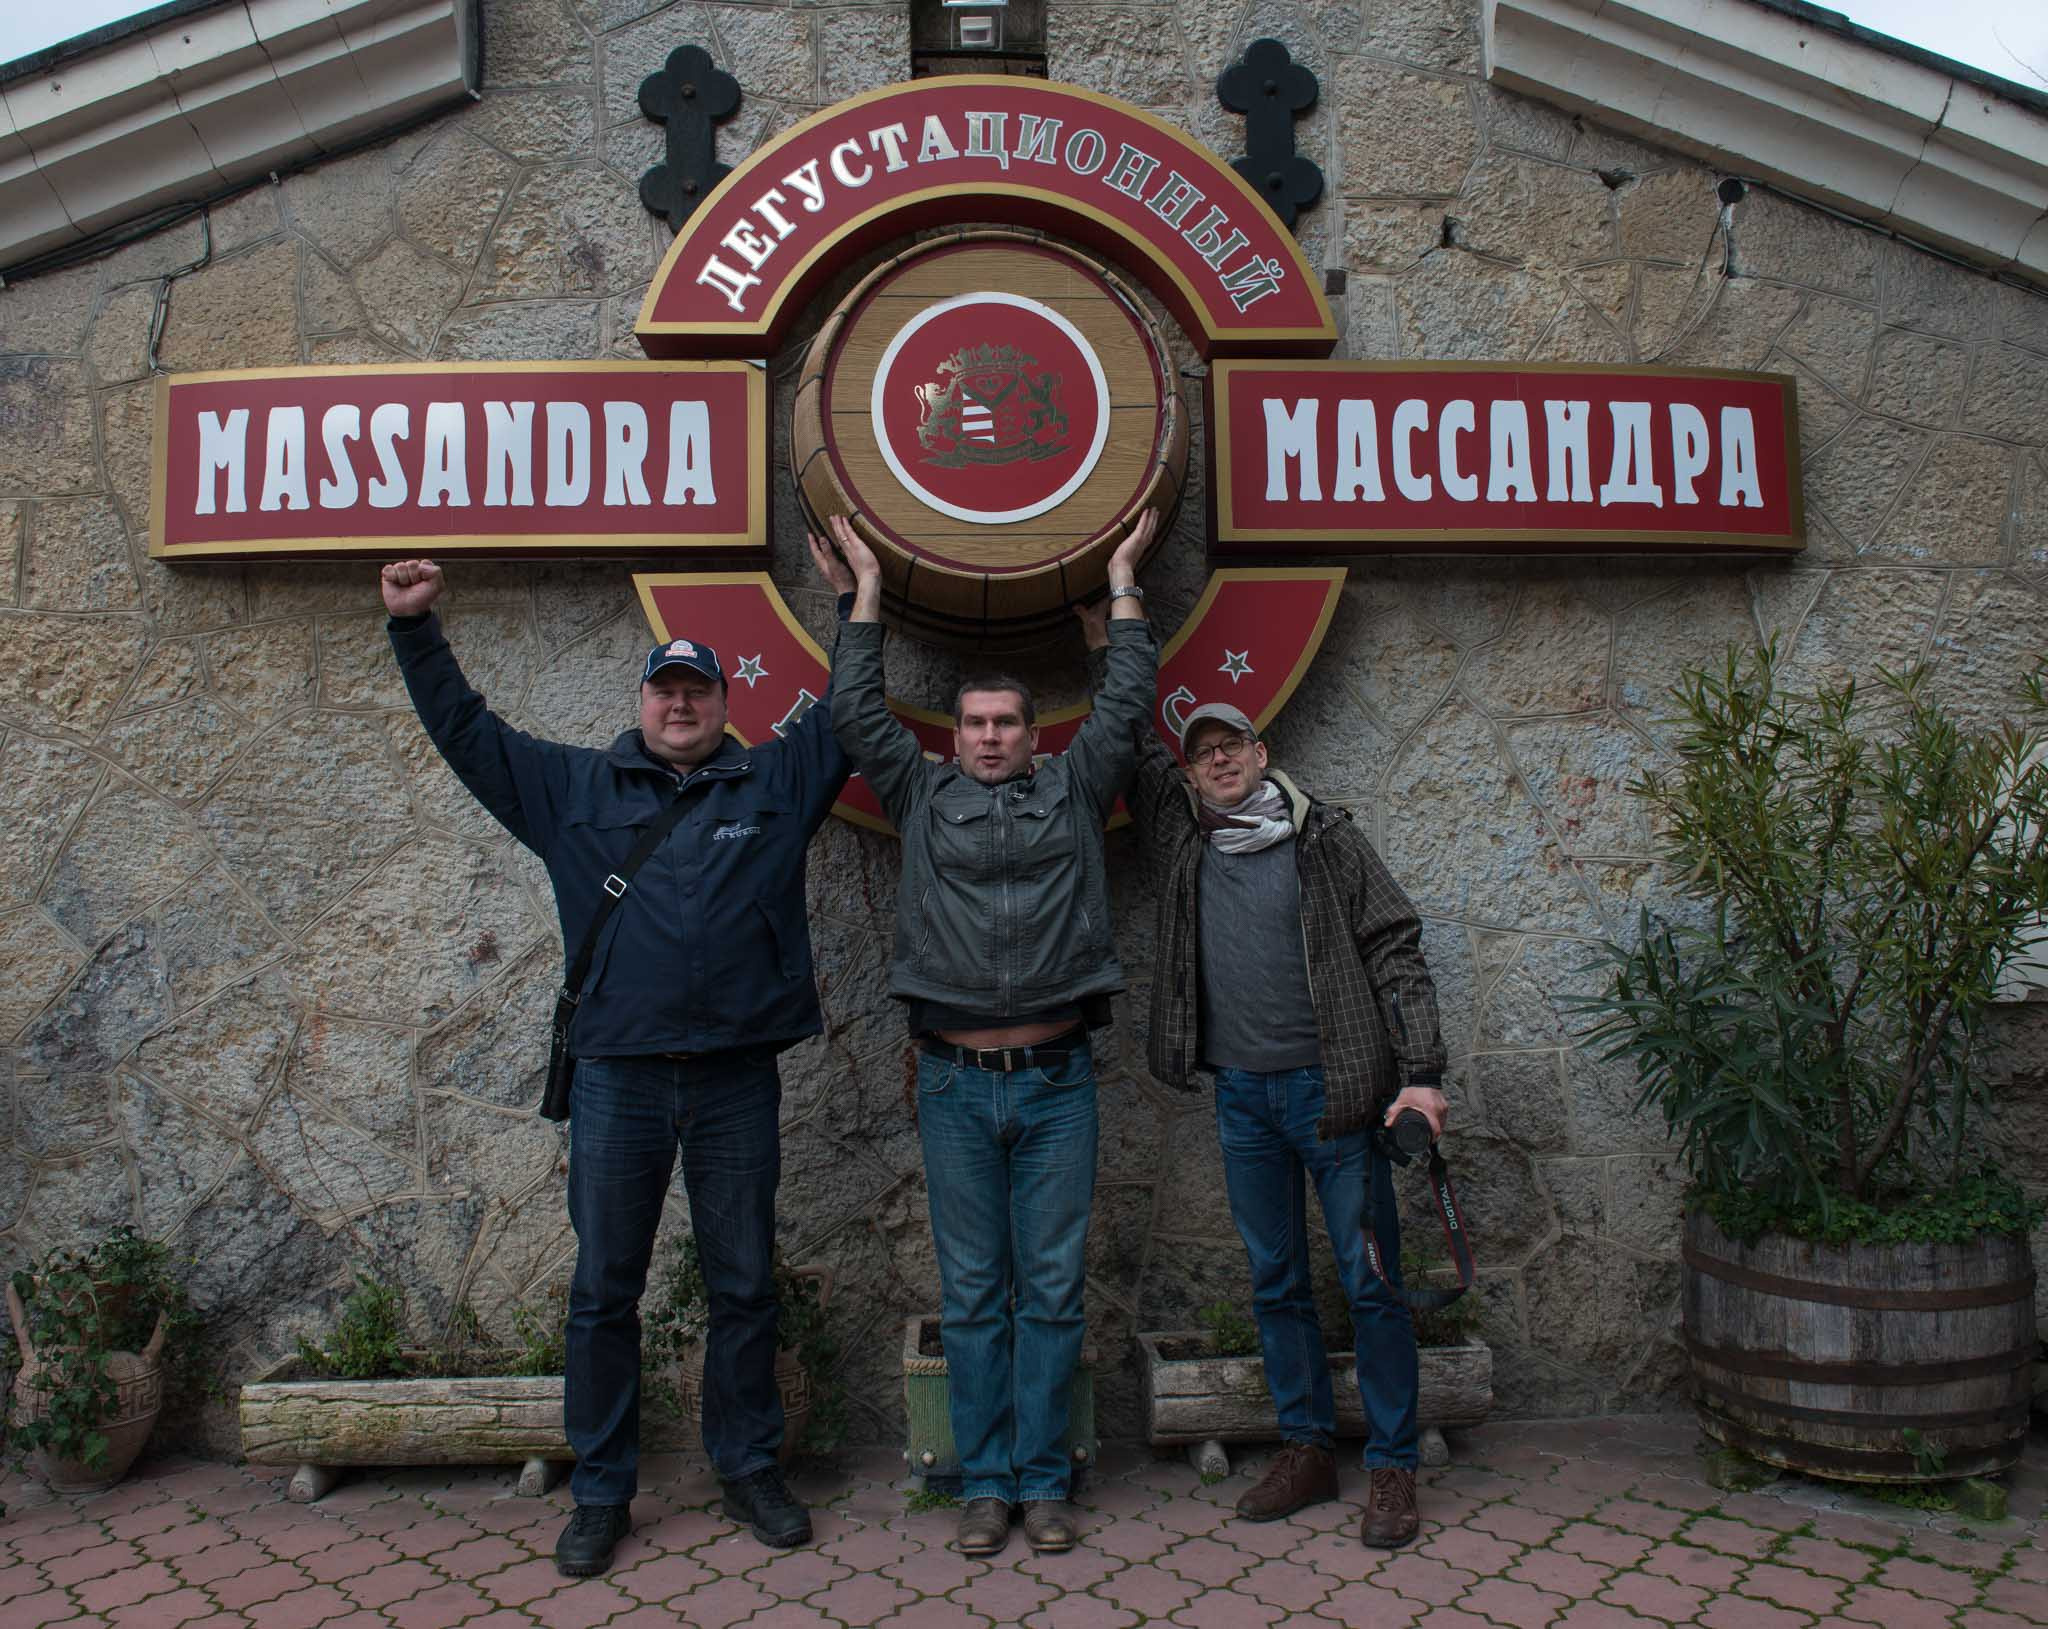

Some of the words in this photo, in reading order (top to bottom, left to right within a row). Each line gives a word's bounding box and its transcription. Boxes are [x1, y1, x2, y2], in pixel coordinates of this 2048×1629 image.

[696, 110, 1285, 313] ДЕГУСТАЦИОННЫЙ
[194, 400, 717, 515] MASSANDRA
[1262, 398, 1764, 508] МАССАНДРА
[1440, 1183, 1458, 1230] DIGITAL
